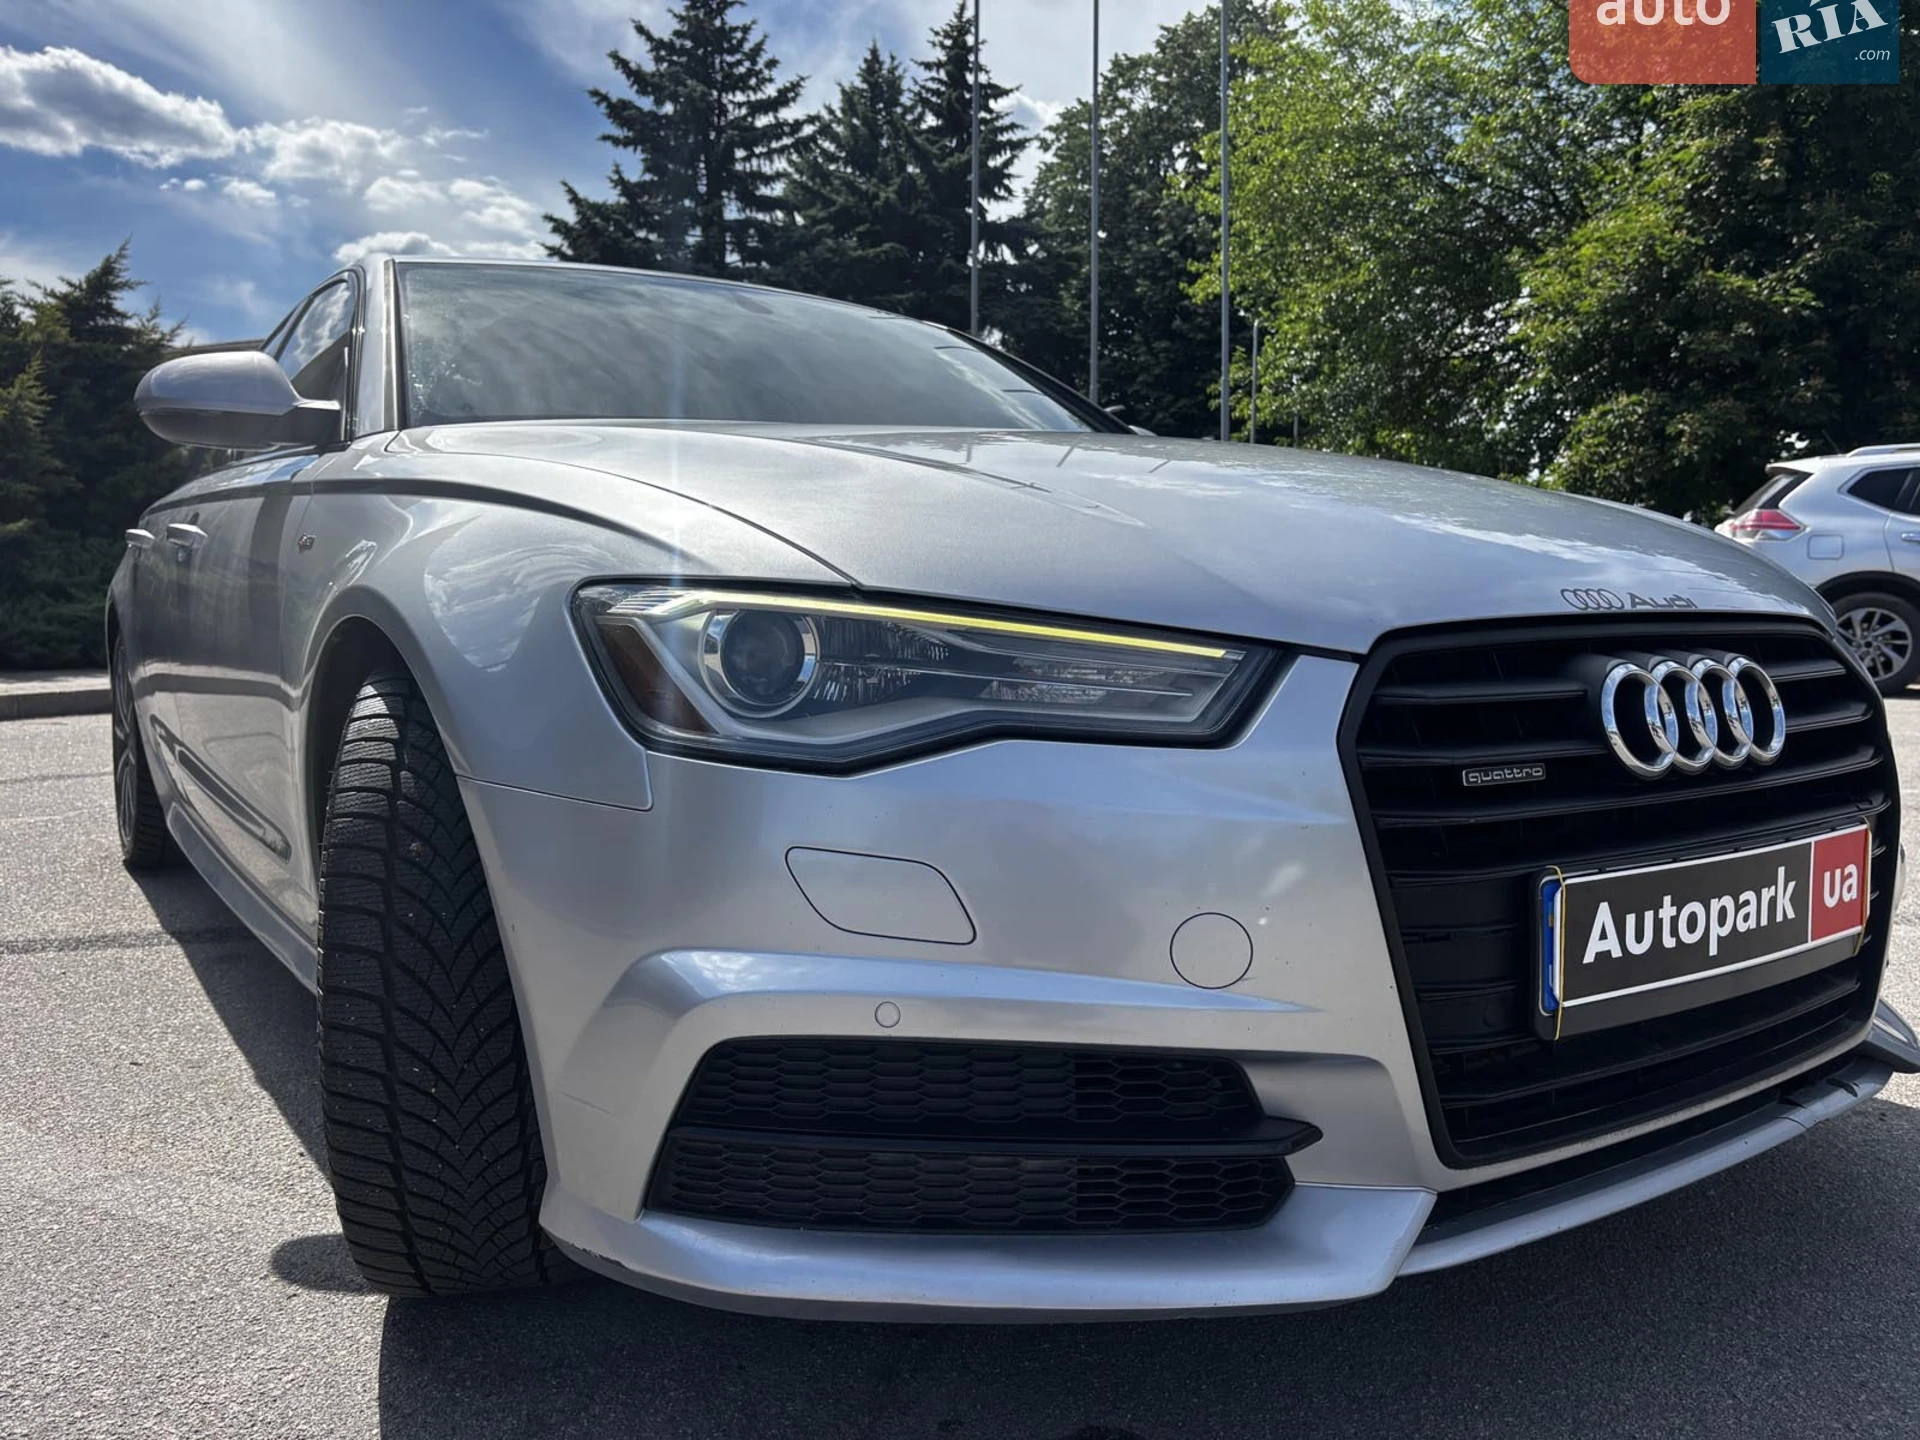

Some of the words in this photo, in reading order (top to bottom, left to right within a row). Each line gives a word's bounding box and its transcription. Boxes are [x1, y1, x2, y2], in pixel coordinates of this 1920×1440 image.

[1468, 767, 1543, 783] quattro
[1582, 866, 1796, 964] Autopark
[1823, 863, 1858, 908] ua
